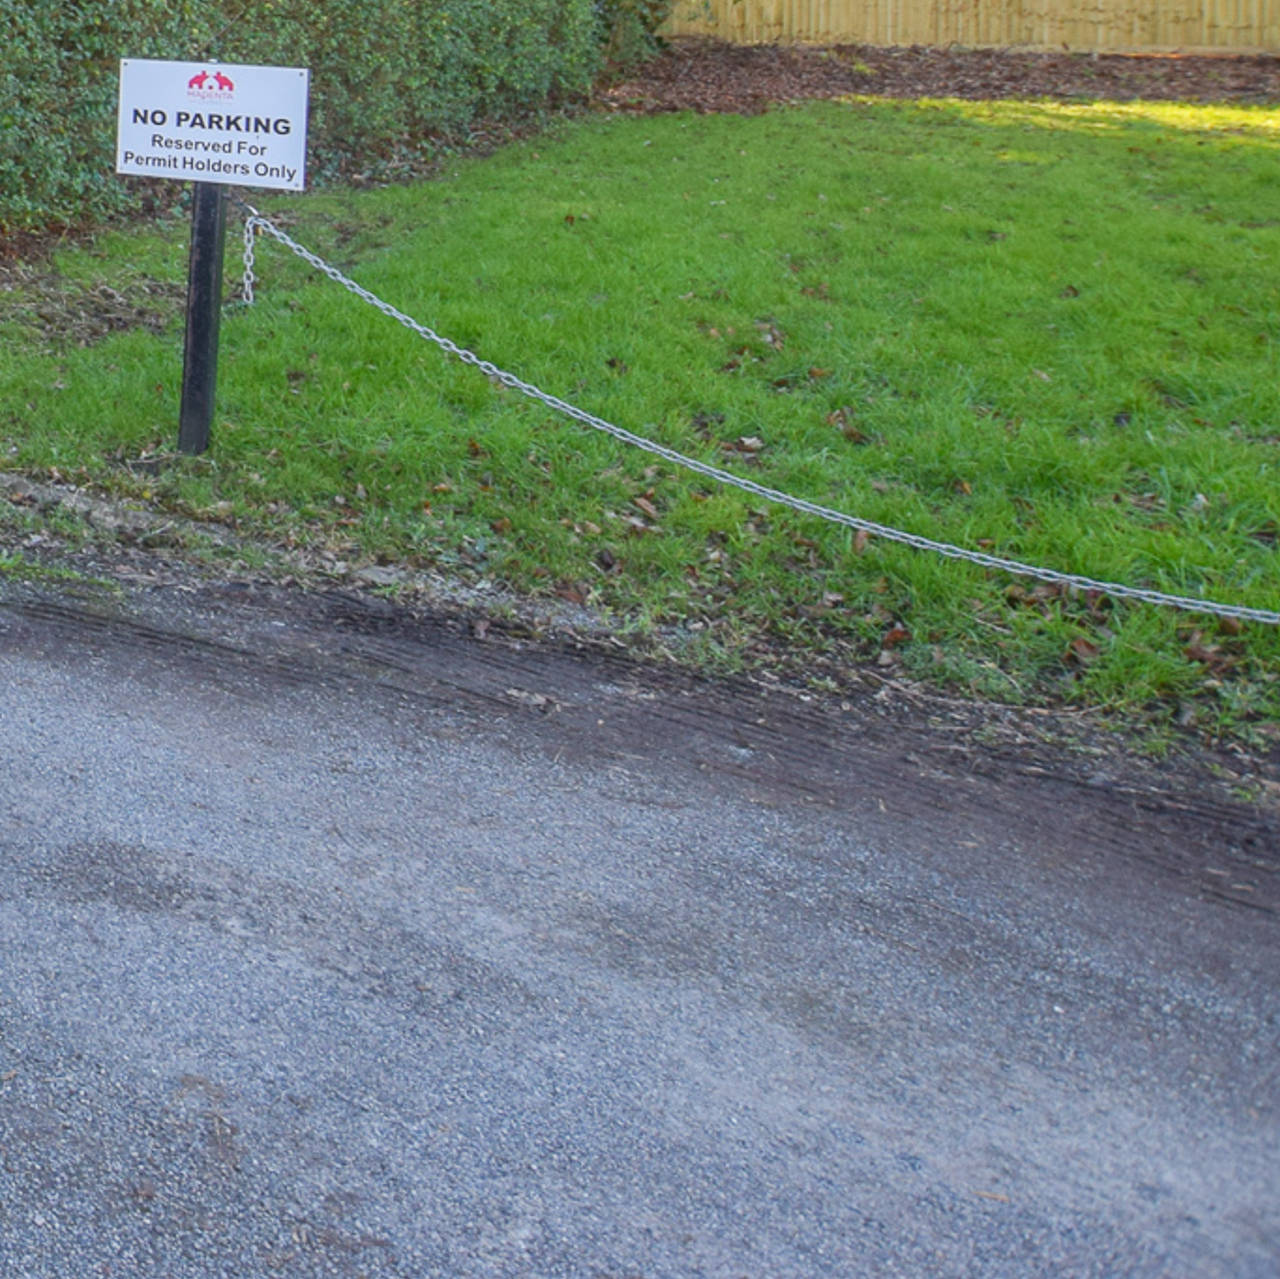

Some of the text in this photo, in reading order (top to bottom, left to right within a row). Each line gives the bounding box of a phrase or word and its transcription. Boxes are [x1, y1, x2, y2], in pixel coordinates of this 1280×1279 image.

[132, 108, 291, 135] NO PARKING
[151, 134, 268, 156] Reserved For
[124, 151, 297, 182] Permit Holders Only
